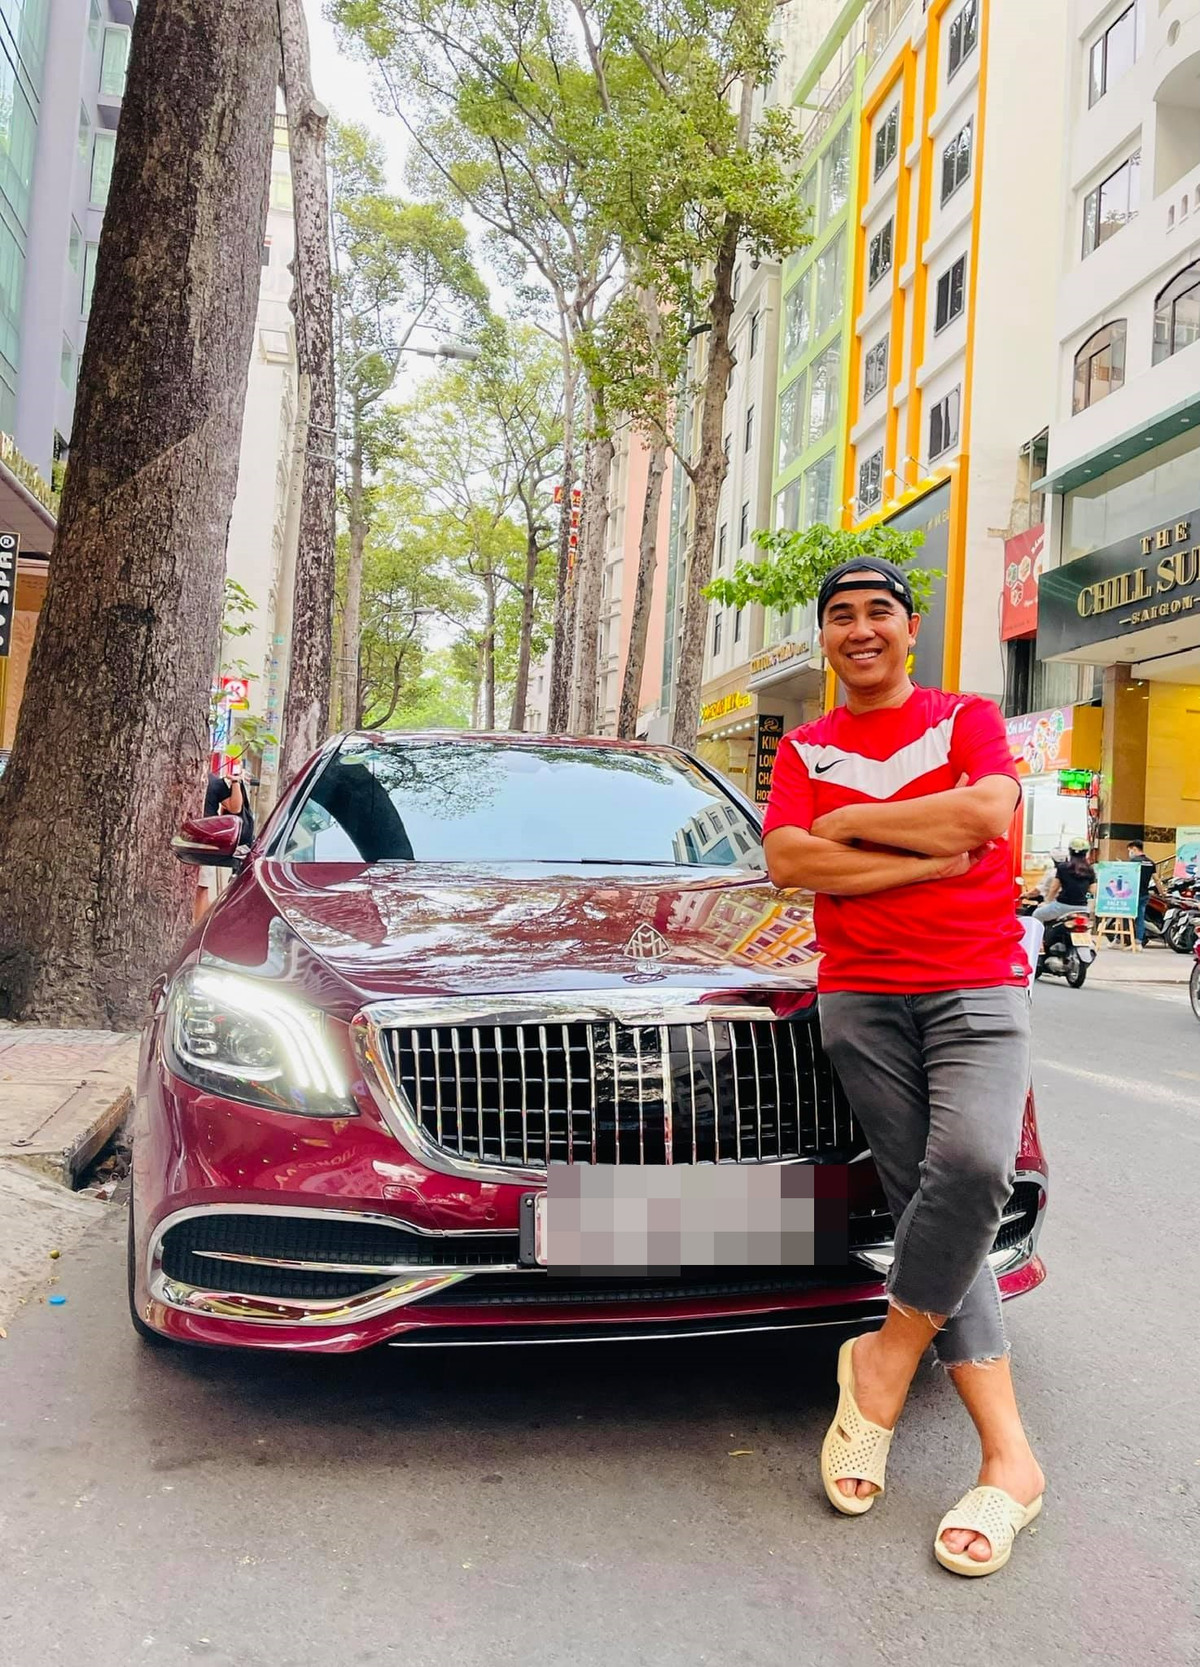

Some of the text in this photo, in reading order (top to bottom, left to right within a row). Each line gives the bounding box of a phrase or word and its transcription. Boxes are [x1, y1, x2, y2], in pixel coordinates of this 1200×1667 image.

[1140, 521, 1190, 555] THE
[1077, 567, 1152, 618] CHILL
[1131, 595, 1193, 624] SAIGON
[759, 755, 775, 767] LON
[756, 789, 769, 801] HOT
